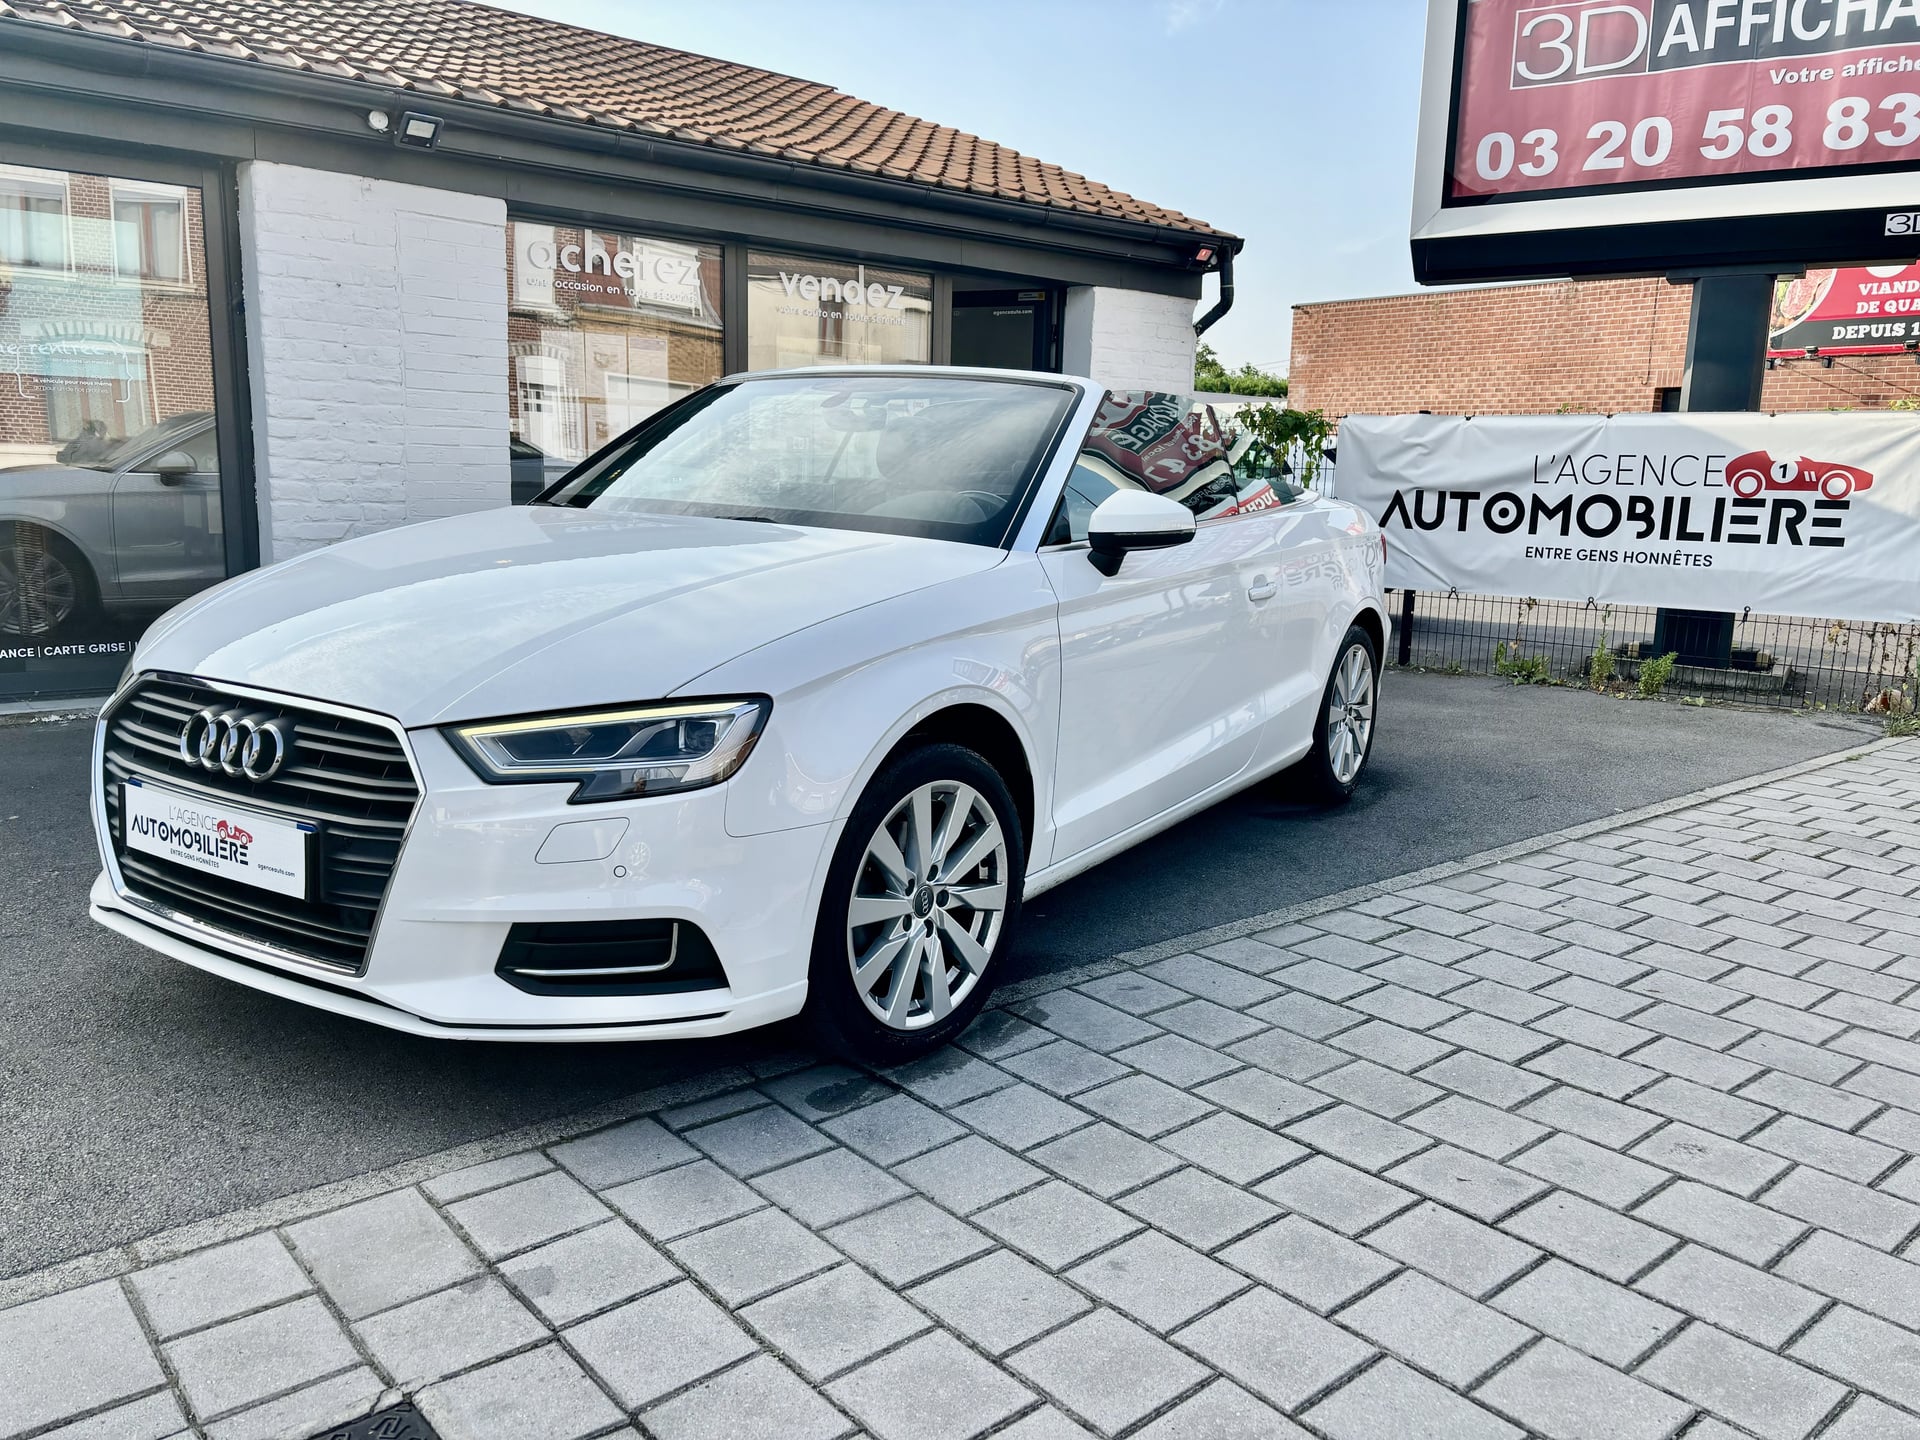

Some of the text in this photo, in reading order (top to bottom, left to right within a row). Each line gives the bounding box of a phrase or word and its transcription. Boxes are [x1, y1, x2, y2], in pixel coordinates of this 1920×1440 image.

[1515, 5, 1649, 81] 3D
[1769, 58, 1834, 85] Votre
[1475, 92, 1920, 181] 03 20 58 83
[527, 229, 701, 286] achetez
[555, 280, 603, 293] occasion
[607, 285, 620, 293] en
[779, 264, 905, 310] vendez
[1858, 280, 1920, 296] VIAND
[830, 311, 842, 319] en
[1856, 300, 1880, 314] DE
[1832, 323, 1906, 340] DEPUIS
[1533, 454, 1726, 487] L'AGENCE
[1525, 546, 1713, 567] ENTRE GENS HONNÊTES
[43, 644, 86, 656] CARTE
[88, 642, 126, 653] GRISE
